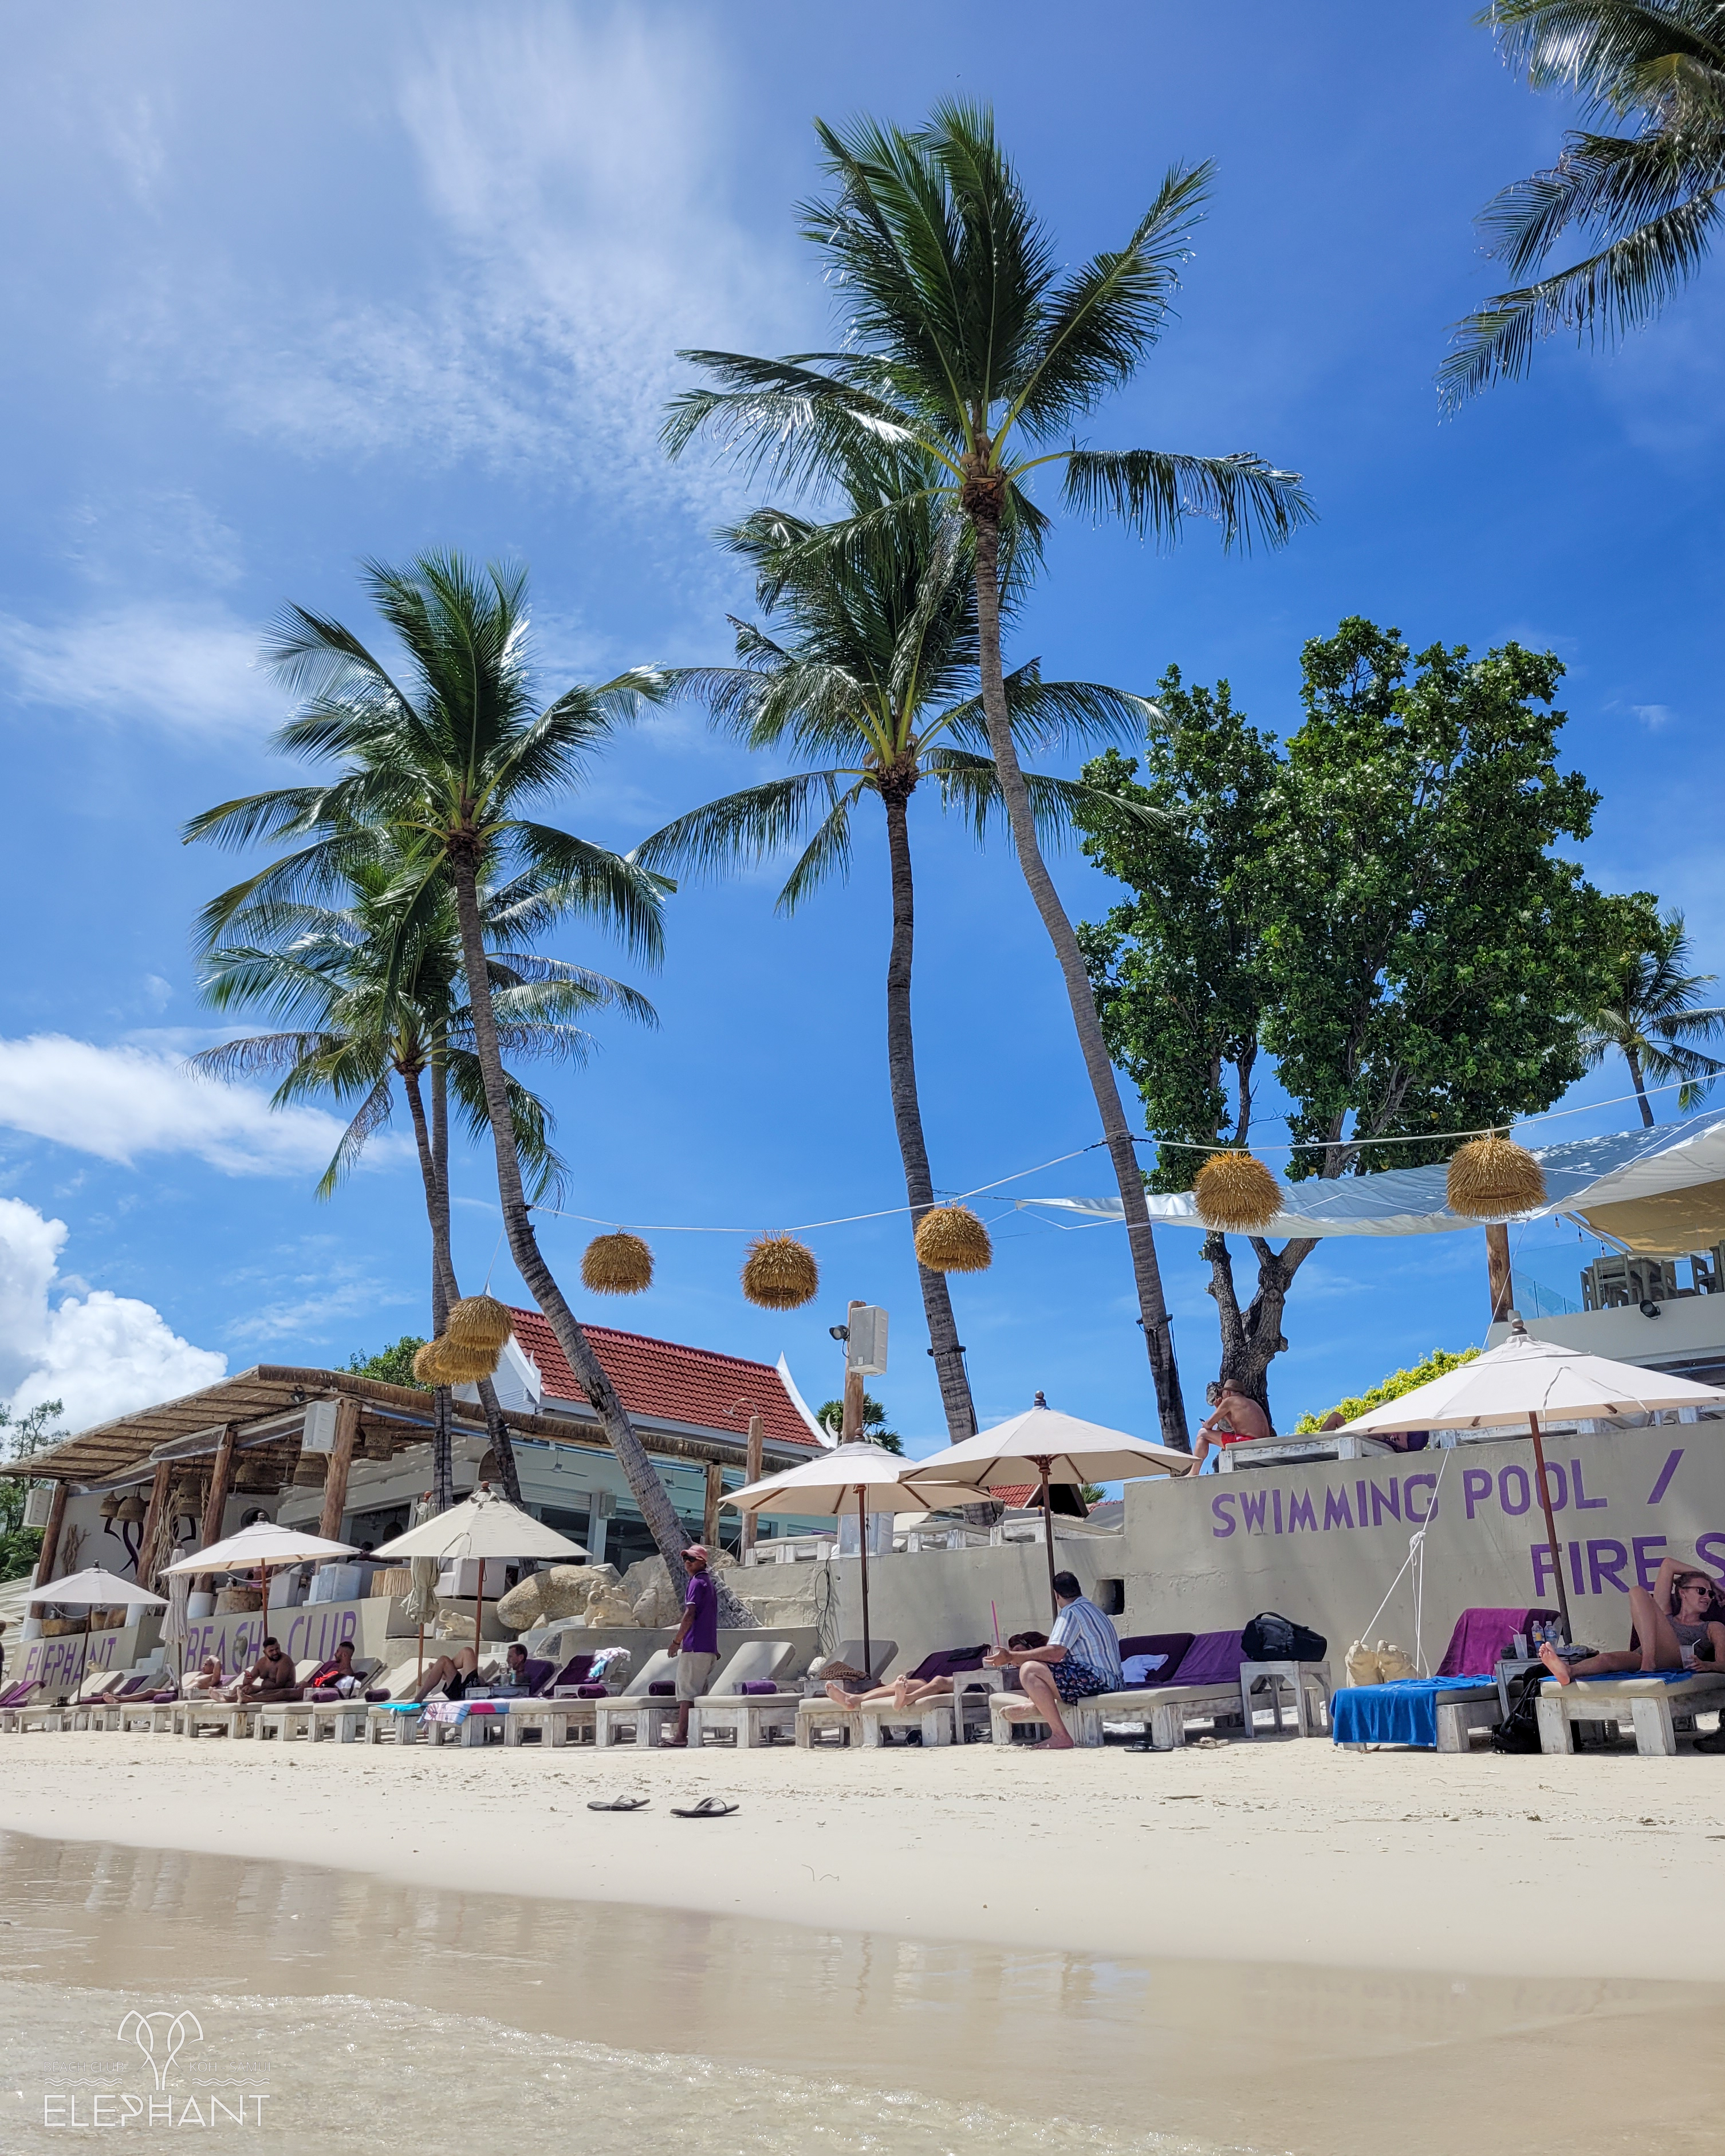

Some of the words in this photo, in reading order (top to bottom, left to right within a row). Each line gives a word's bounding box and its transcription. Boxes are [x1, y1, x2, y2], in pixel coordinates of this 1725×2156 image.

[1211, 1473, 1439, 1538] SWIMMING
[1462, 1459, 1608, 1519] POOL
[1530, 1535, 1667, 1597] FIRE
[184, 1620, 263, 1676] BEACH
